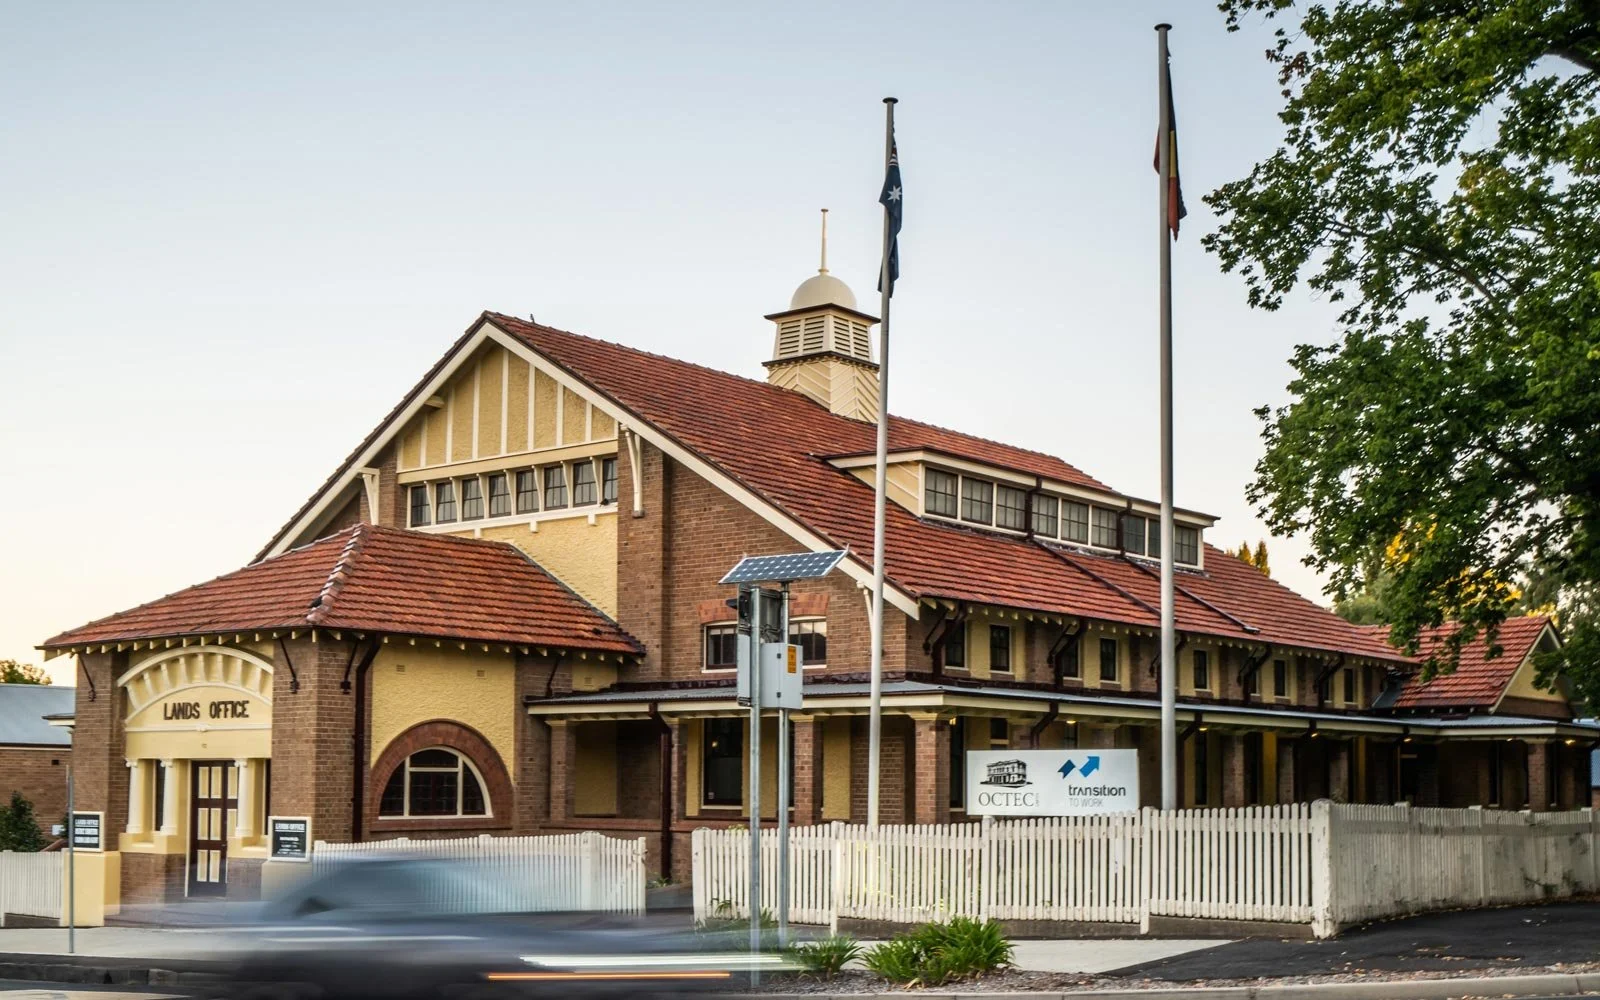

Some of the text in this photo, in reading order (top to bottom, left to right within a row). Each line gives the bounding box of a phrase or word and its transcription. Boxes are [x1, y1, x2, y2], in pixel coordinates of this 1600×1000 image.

[163, 700, 250, 720] LANDS OFFICE
[1068, 784, 1126, 797] transition
[978, 792, 1034, 807] OCTEC
[1069, 797, 1104, 807] TO WORK
